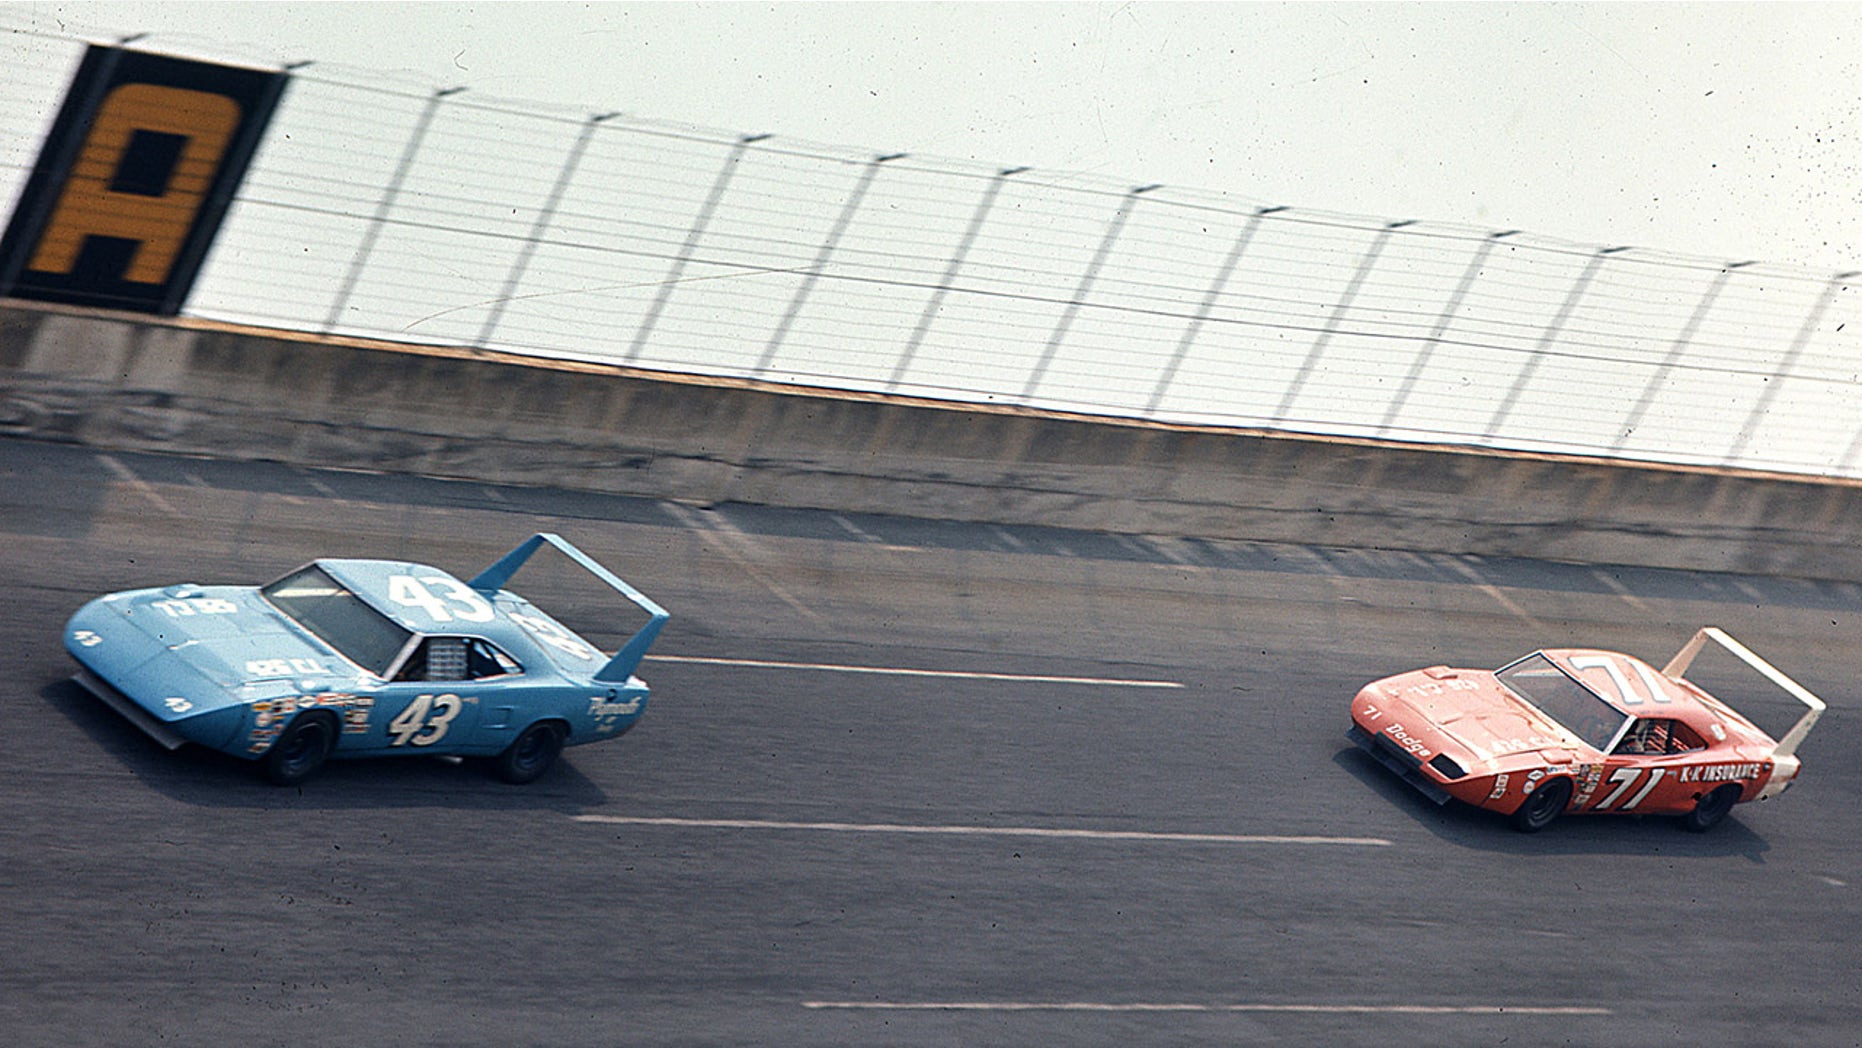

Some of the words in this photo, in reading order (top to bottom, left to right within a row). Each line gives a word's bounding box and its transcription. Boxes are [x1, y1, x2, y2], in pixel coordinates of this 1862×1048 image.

[26, 83, 243, 285] A
[387, 574, 496, 623] 43
[73, 630, 103, 646] 43
[1568, 656, 1671, 704] 71
[164, 697, 194, 713] 43
[389, 693, 463, 747] 43
[1363, 704, 1383, 721] 71
[1385, 723, 1433, 757] Dodge
[1595, 767, 1667, 809] 71
[1702, 763, 1761, 781] INSURANCE
